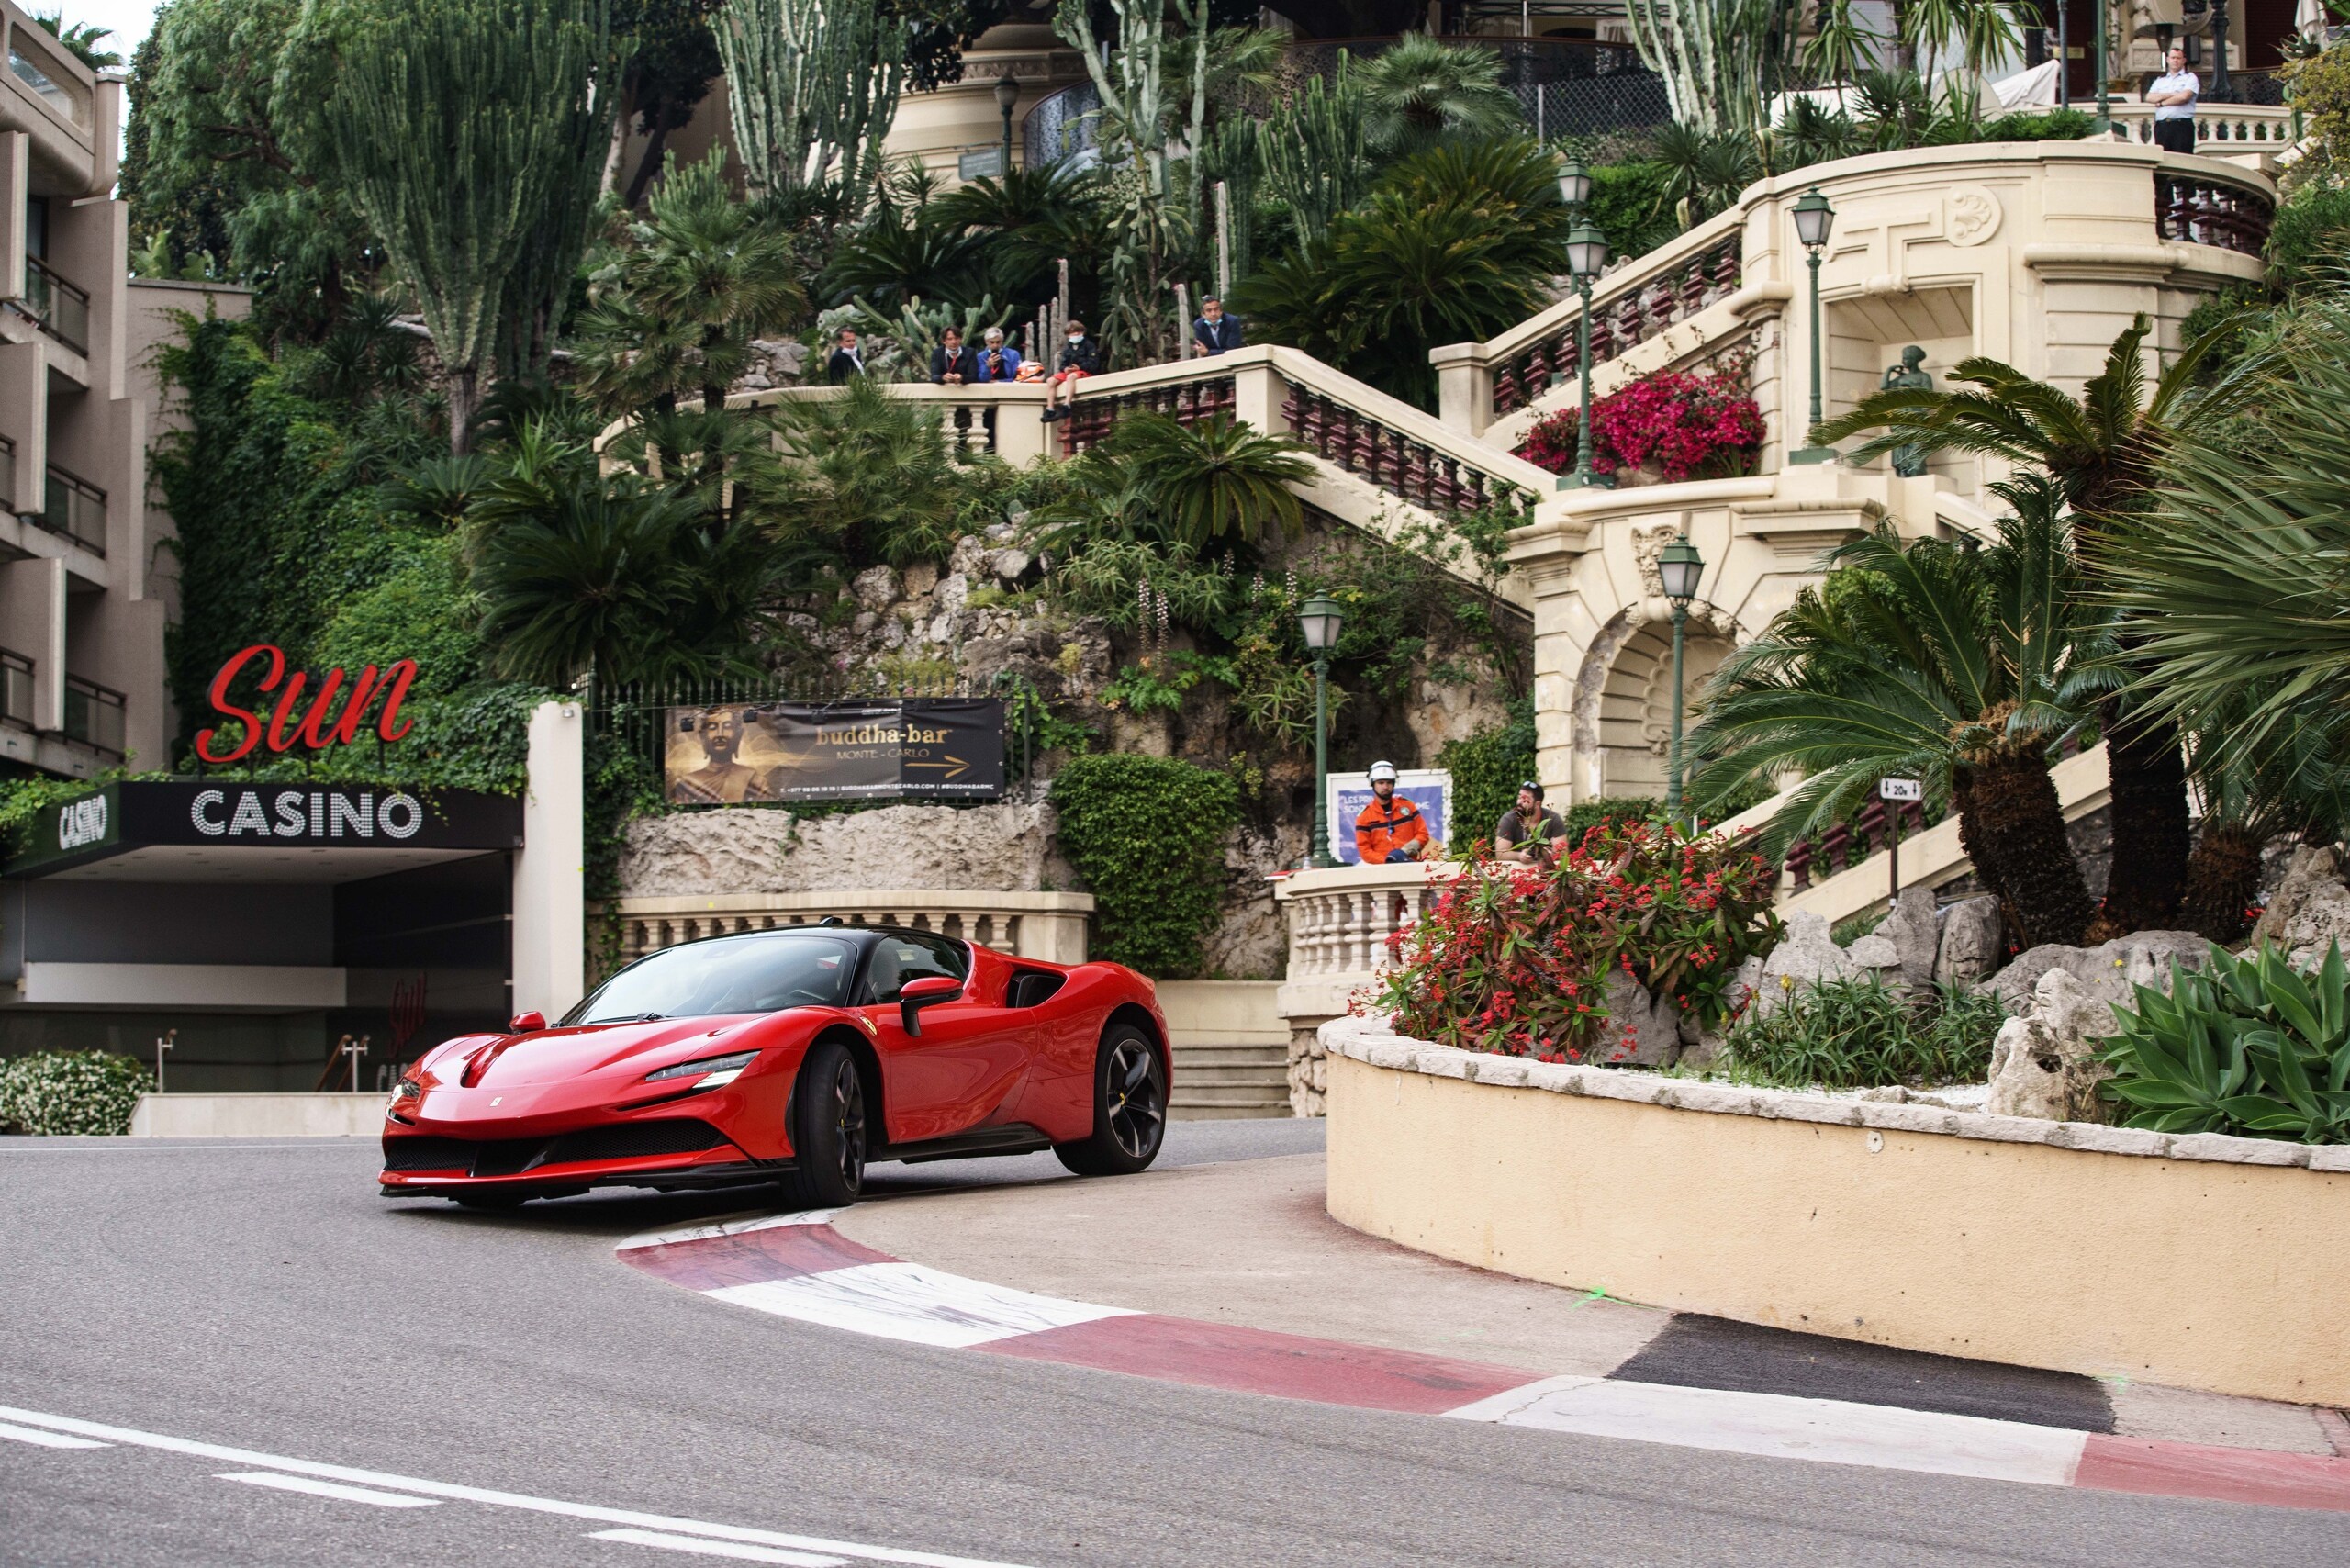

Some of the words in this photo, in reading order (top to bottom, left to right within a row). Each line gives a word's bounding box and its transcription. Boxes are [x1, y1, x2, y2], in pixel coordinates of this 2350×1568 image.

[195, 644, 419, 763] Sun
[836, 749, 878, 759] MONTE
[887, 748, 930, 758] CARLO
[59, 794, 108, 850] CASINO
[191, 790, 423, 839] CASINO
